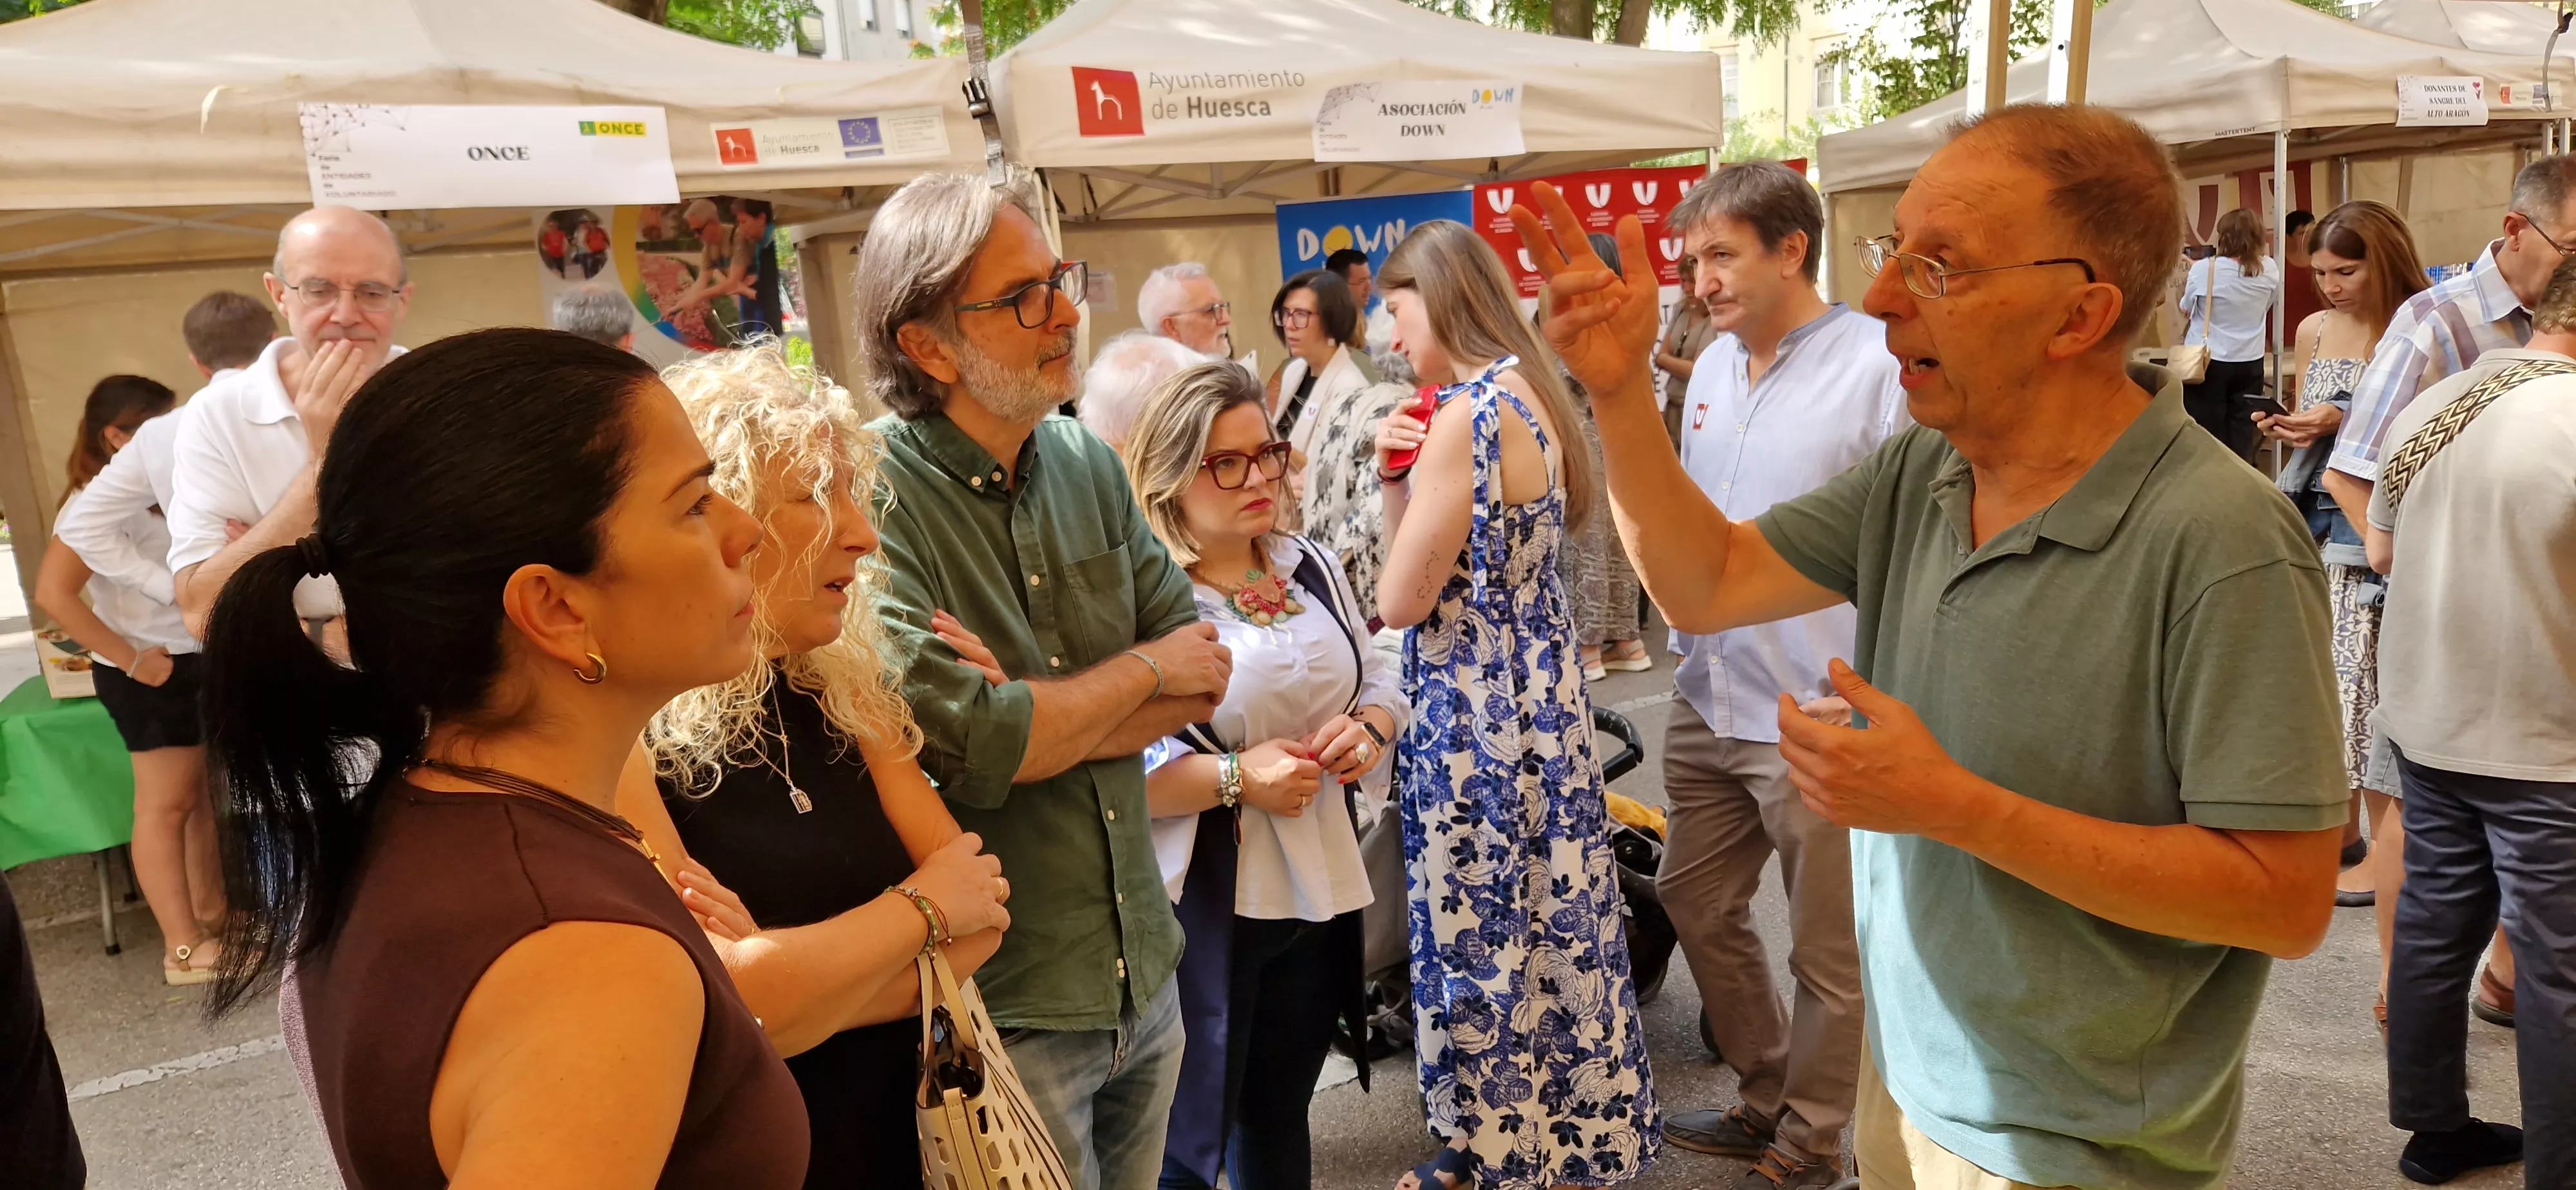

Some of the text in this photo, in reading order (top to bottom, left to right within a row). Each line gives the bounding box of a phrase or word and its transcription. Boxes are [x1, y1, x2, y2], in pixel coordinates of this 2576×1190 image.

[1149, 70, 1305, 95] Ayuntamiento
[2424, 84, 2467, 93] DONANTES DE
[1472, 88, 1514, 104] DOWN
[2429, 97, 2467, 105] SANGRE DEL
[1152, 96, 1271, 119] de Huesca
[1378, 100, 1466, 117] ASOCIACIÓN
[2426, 109, 2445, 118] ALTO
[2446, 108, 2470, 118] ARAGÓN
[598, 123, 644, 135] ONCE
[1401, 124, 1445, 137] DOWN
[2215, 126, 2256, 137] MASTERTENT
[762, 132, 834, 144] Ayuntamiento
[467, 146, 531, 161] ONCE
[765, 145, 820, 156] de Huesca
